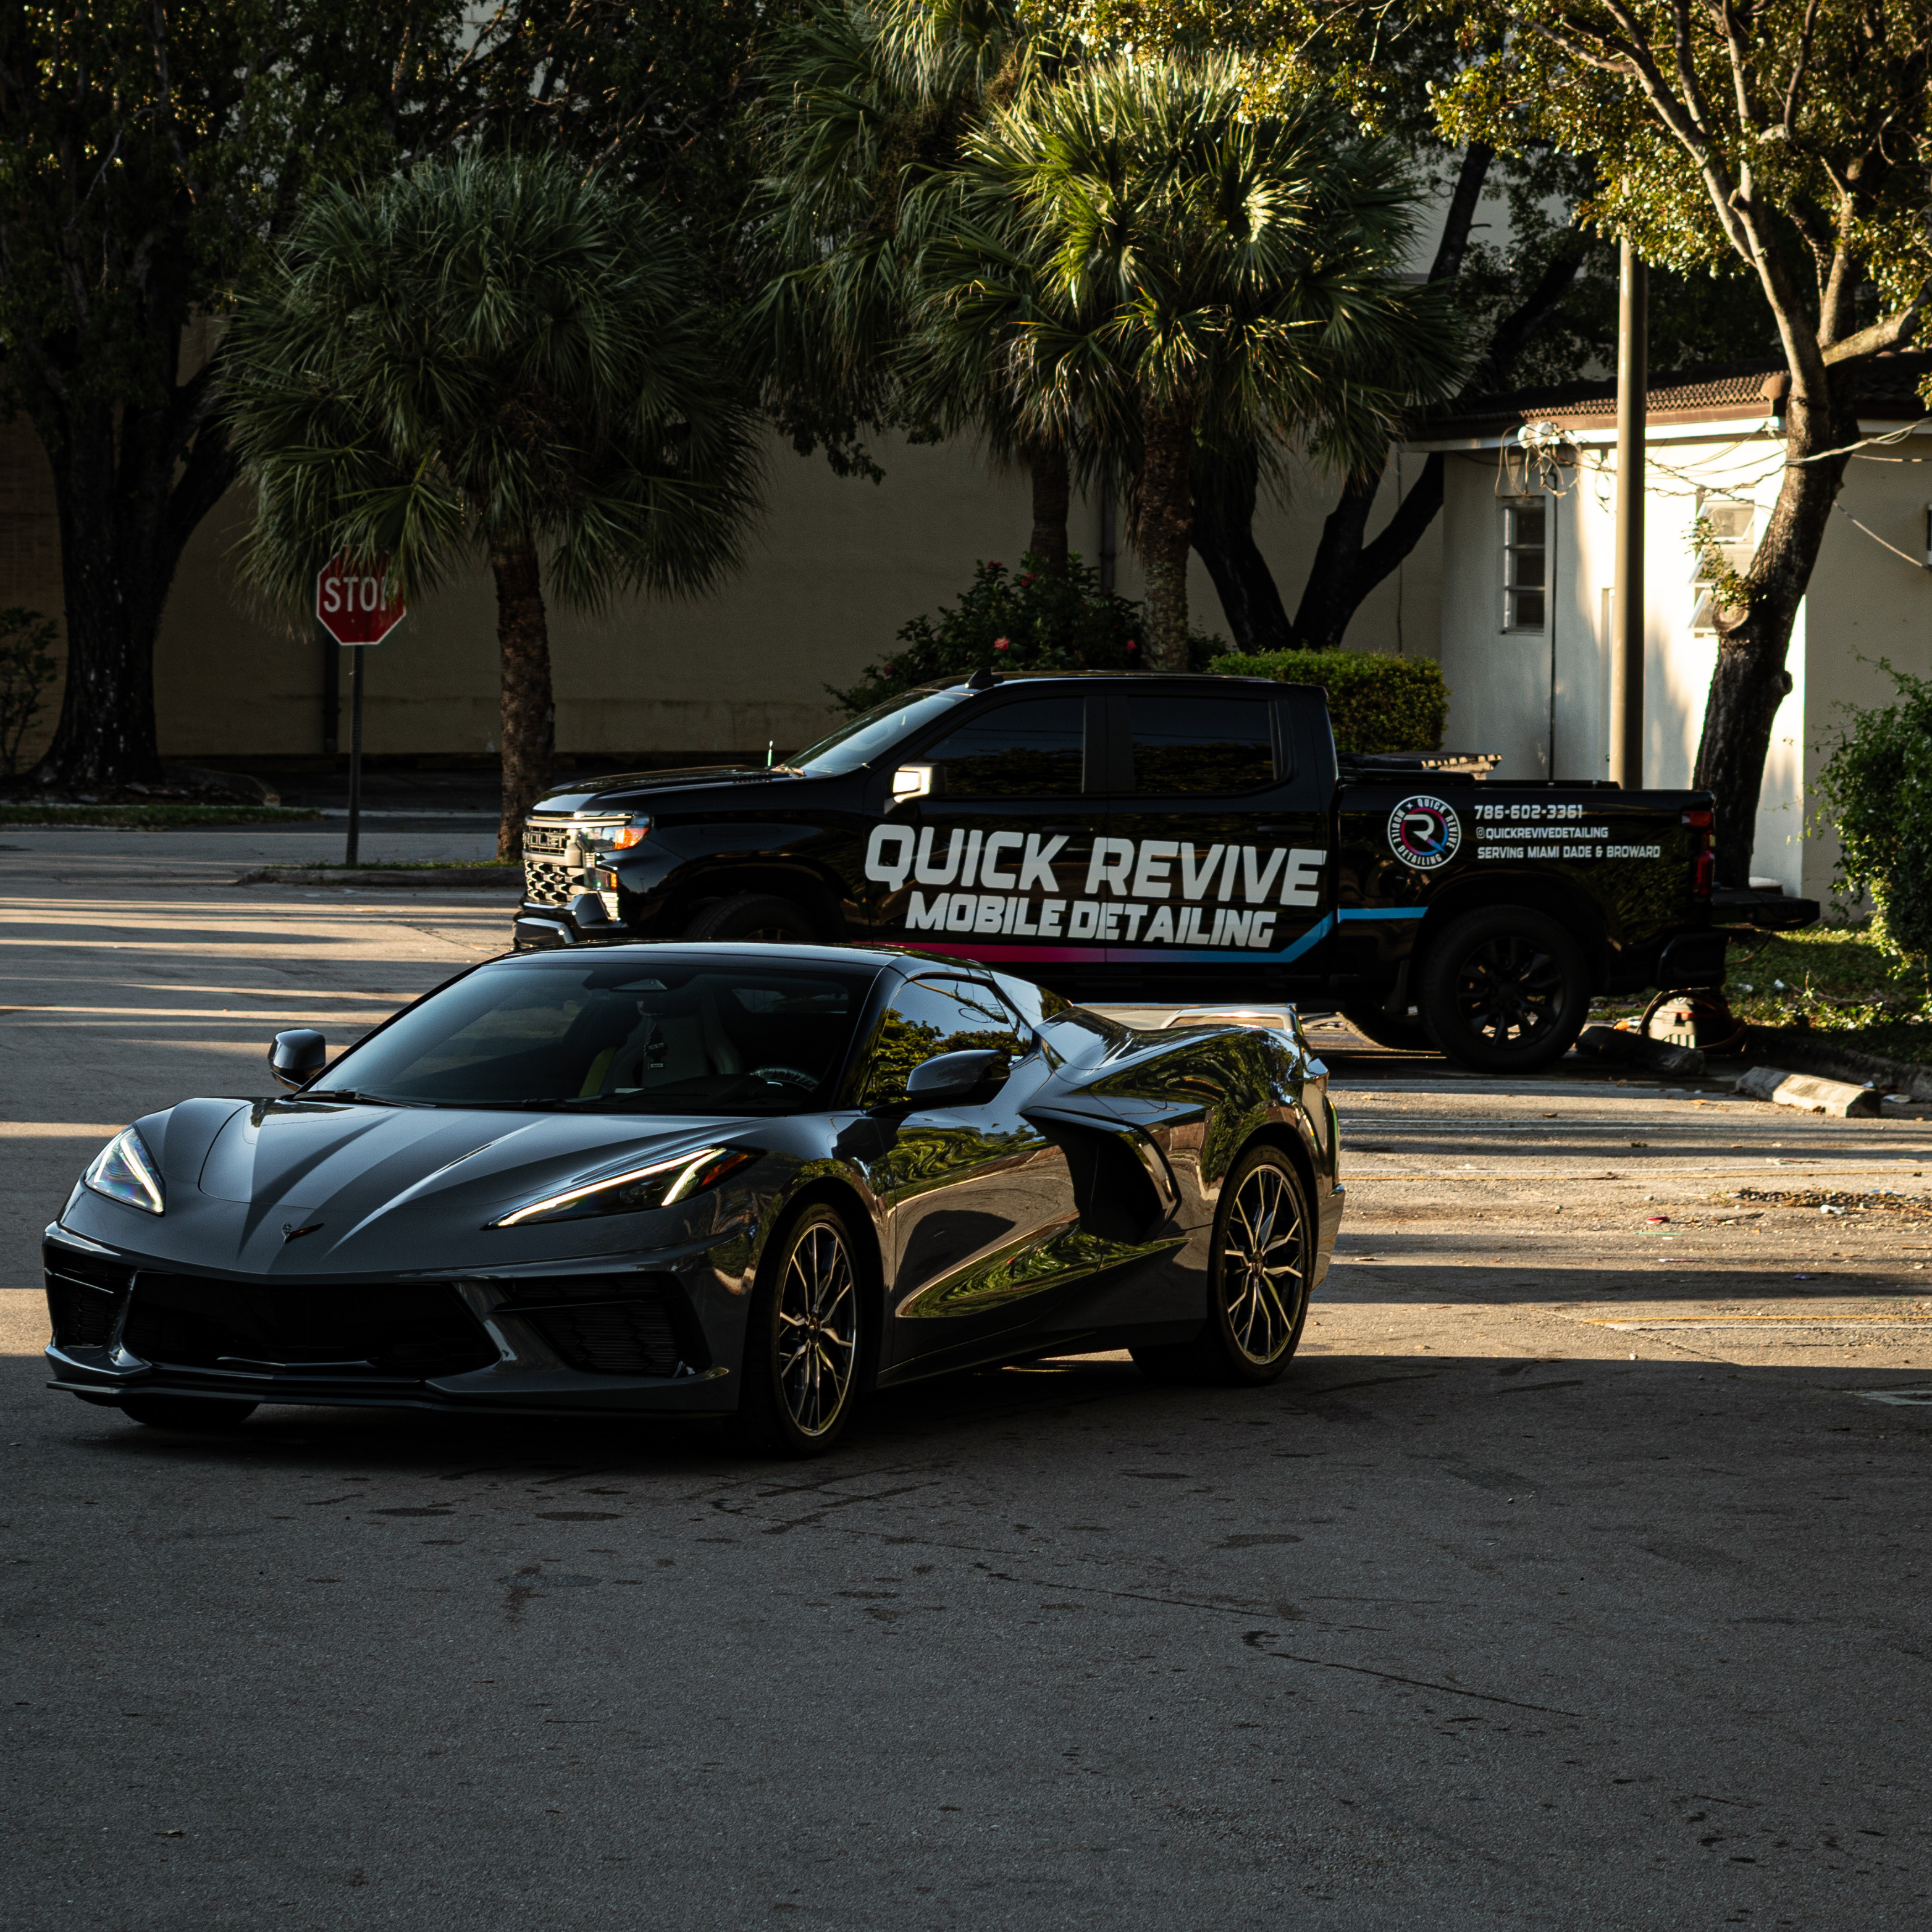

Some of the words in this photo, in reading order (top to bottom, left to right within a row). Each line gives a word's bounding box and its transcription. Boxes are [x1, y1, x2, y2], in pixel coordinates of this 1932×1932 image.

[1418, 798, 1445, 813] QUICK
[1474, 805, 1582, 820] 786-602-3361
[1392, 809, 1405, 843] MOBILE
[1445, 815, 1458, 849] REVIVE
[865, 824, 1070, 892] QUICK
[1085, 837, 1328, 907] REVIVE
[1398, 845, 1442, 865] DETAILING
[1477, 847, 1524, 859] SERVING
[1527, 846, 1560, 858] MIAMI
[1563, 846, 1592, 858] DADE
[1595, 846, 1603, 858] &
[1606, 846, 1660, 858] BROWARD
[905, 891, 1066, 936] MOBILE
[1067, 901, 1277, 948] DETAILING
